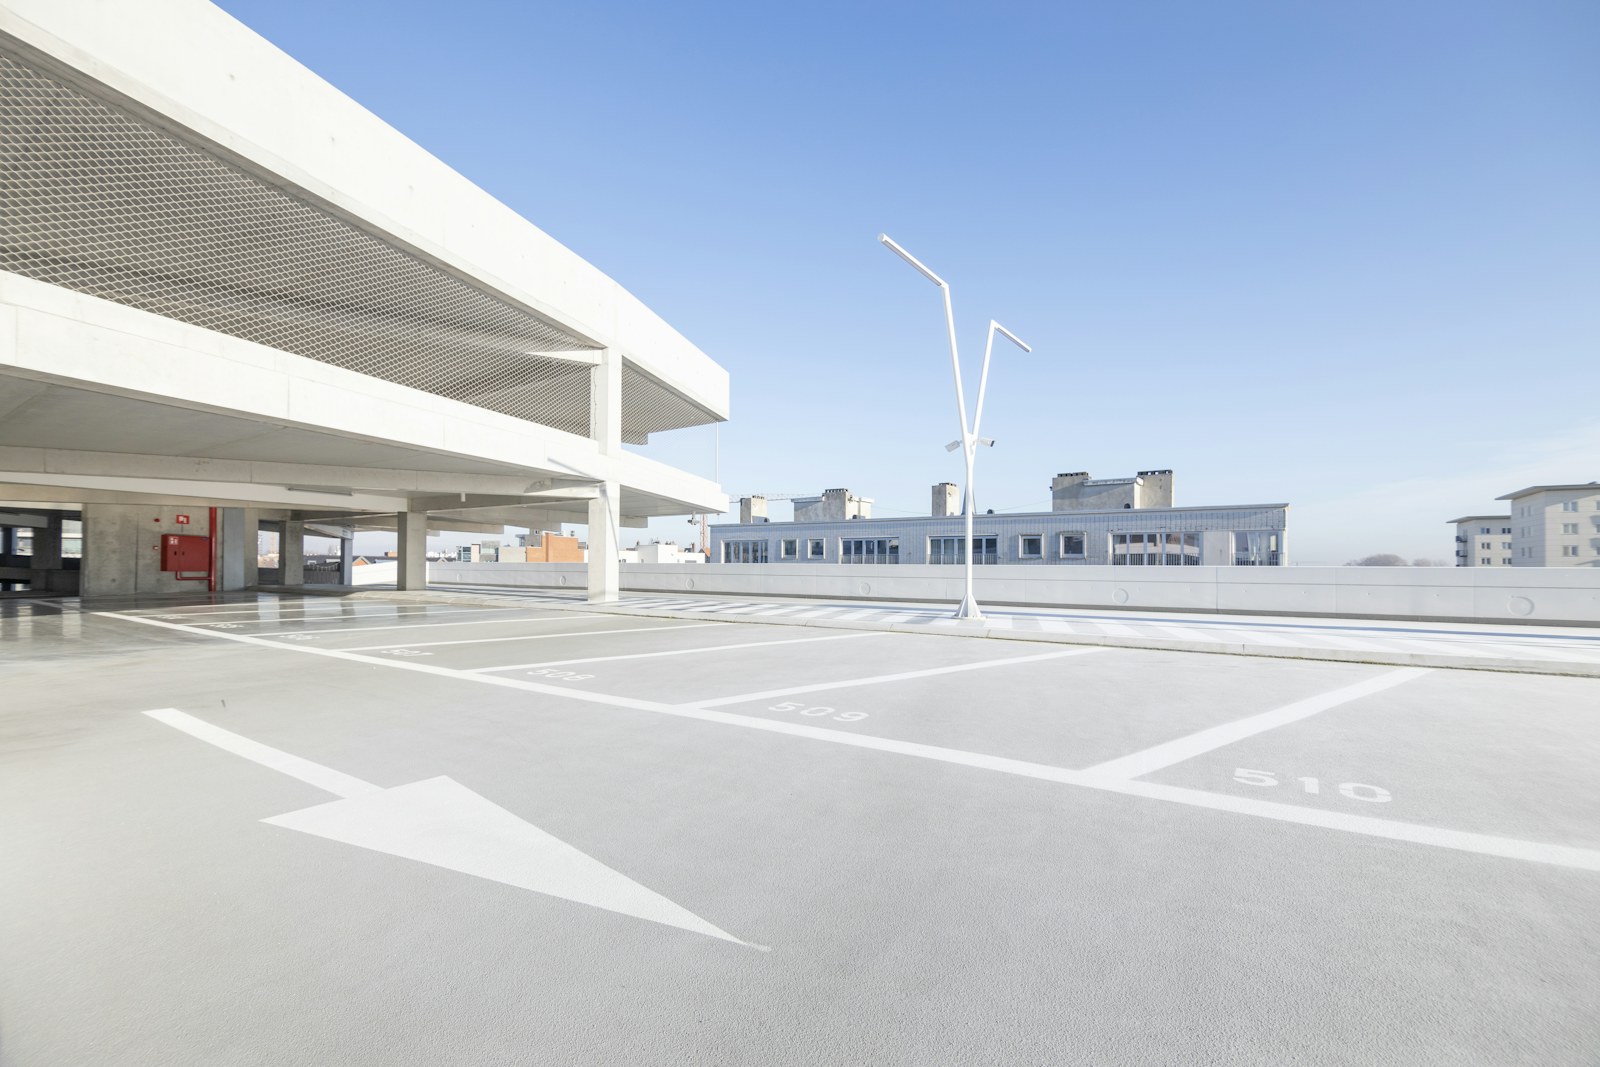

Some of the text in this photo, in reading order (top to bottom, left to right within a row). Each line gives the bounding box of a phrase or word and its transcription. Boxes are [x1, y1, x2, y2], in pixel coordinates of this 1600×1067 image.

[527, 668, 596, 681] 508
[768, 701, 870, 722] 509
[1232, 767, 1393, 803] 510
